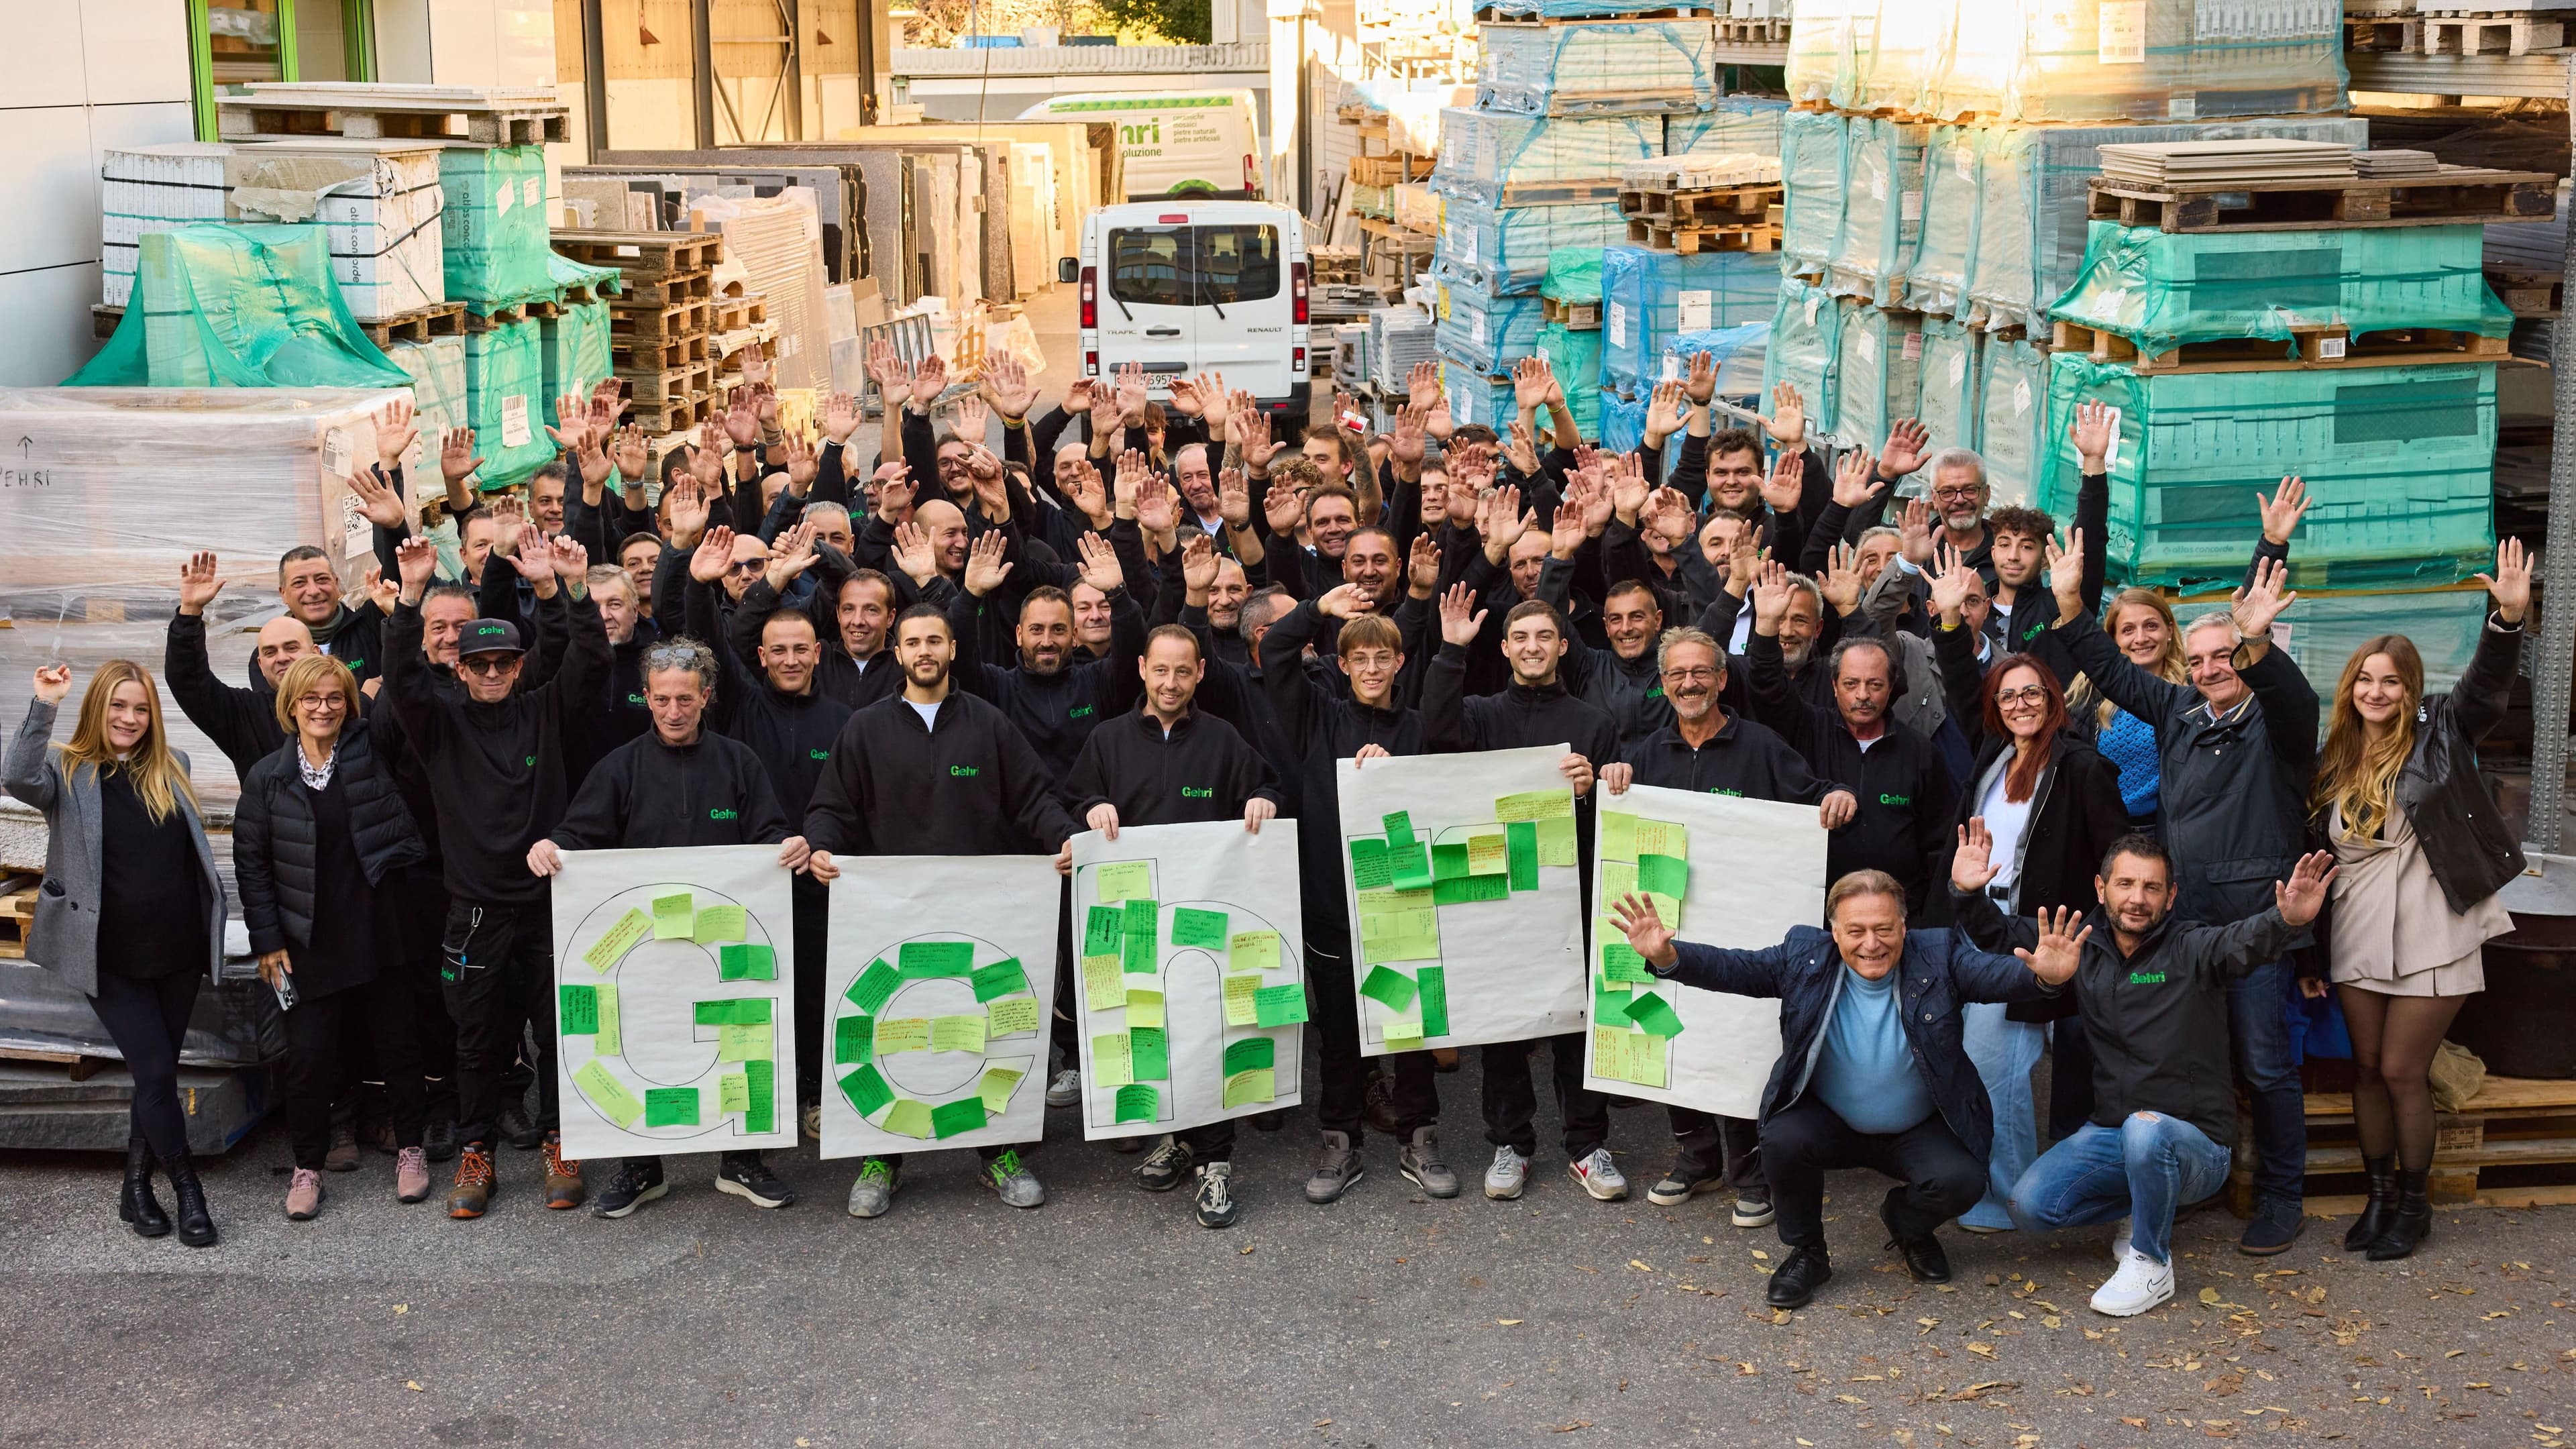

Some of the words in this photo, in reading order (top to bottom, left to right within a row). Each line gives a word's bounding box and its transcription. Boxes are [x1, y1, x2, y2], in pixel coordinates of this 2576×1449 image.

[1193, 127, 1216, 136] naturali
[1173, 136, 1191, 144] pietre
[1122, 147, 1162, 158] oluzione
[351, 235, 361, 283] conorde
[2172, 545, 2194, 554] atlas
[2194, 544, 2234, 553] concorde
[478, 626, 505, 636] Gehri
[346, 657, 364, 670] ehri
[1069, 703, 1093, 718] Gehri
[950, 764, 979, 777] Gehri
[1181, 785, 1213, 798] Gehri
[1880, 793, 1910, 805] Gehri
[2129, 970, 2165, 985] Gehri
